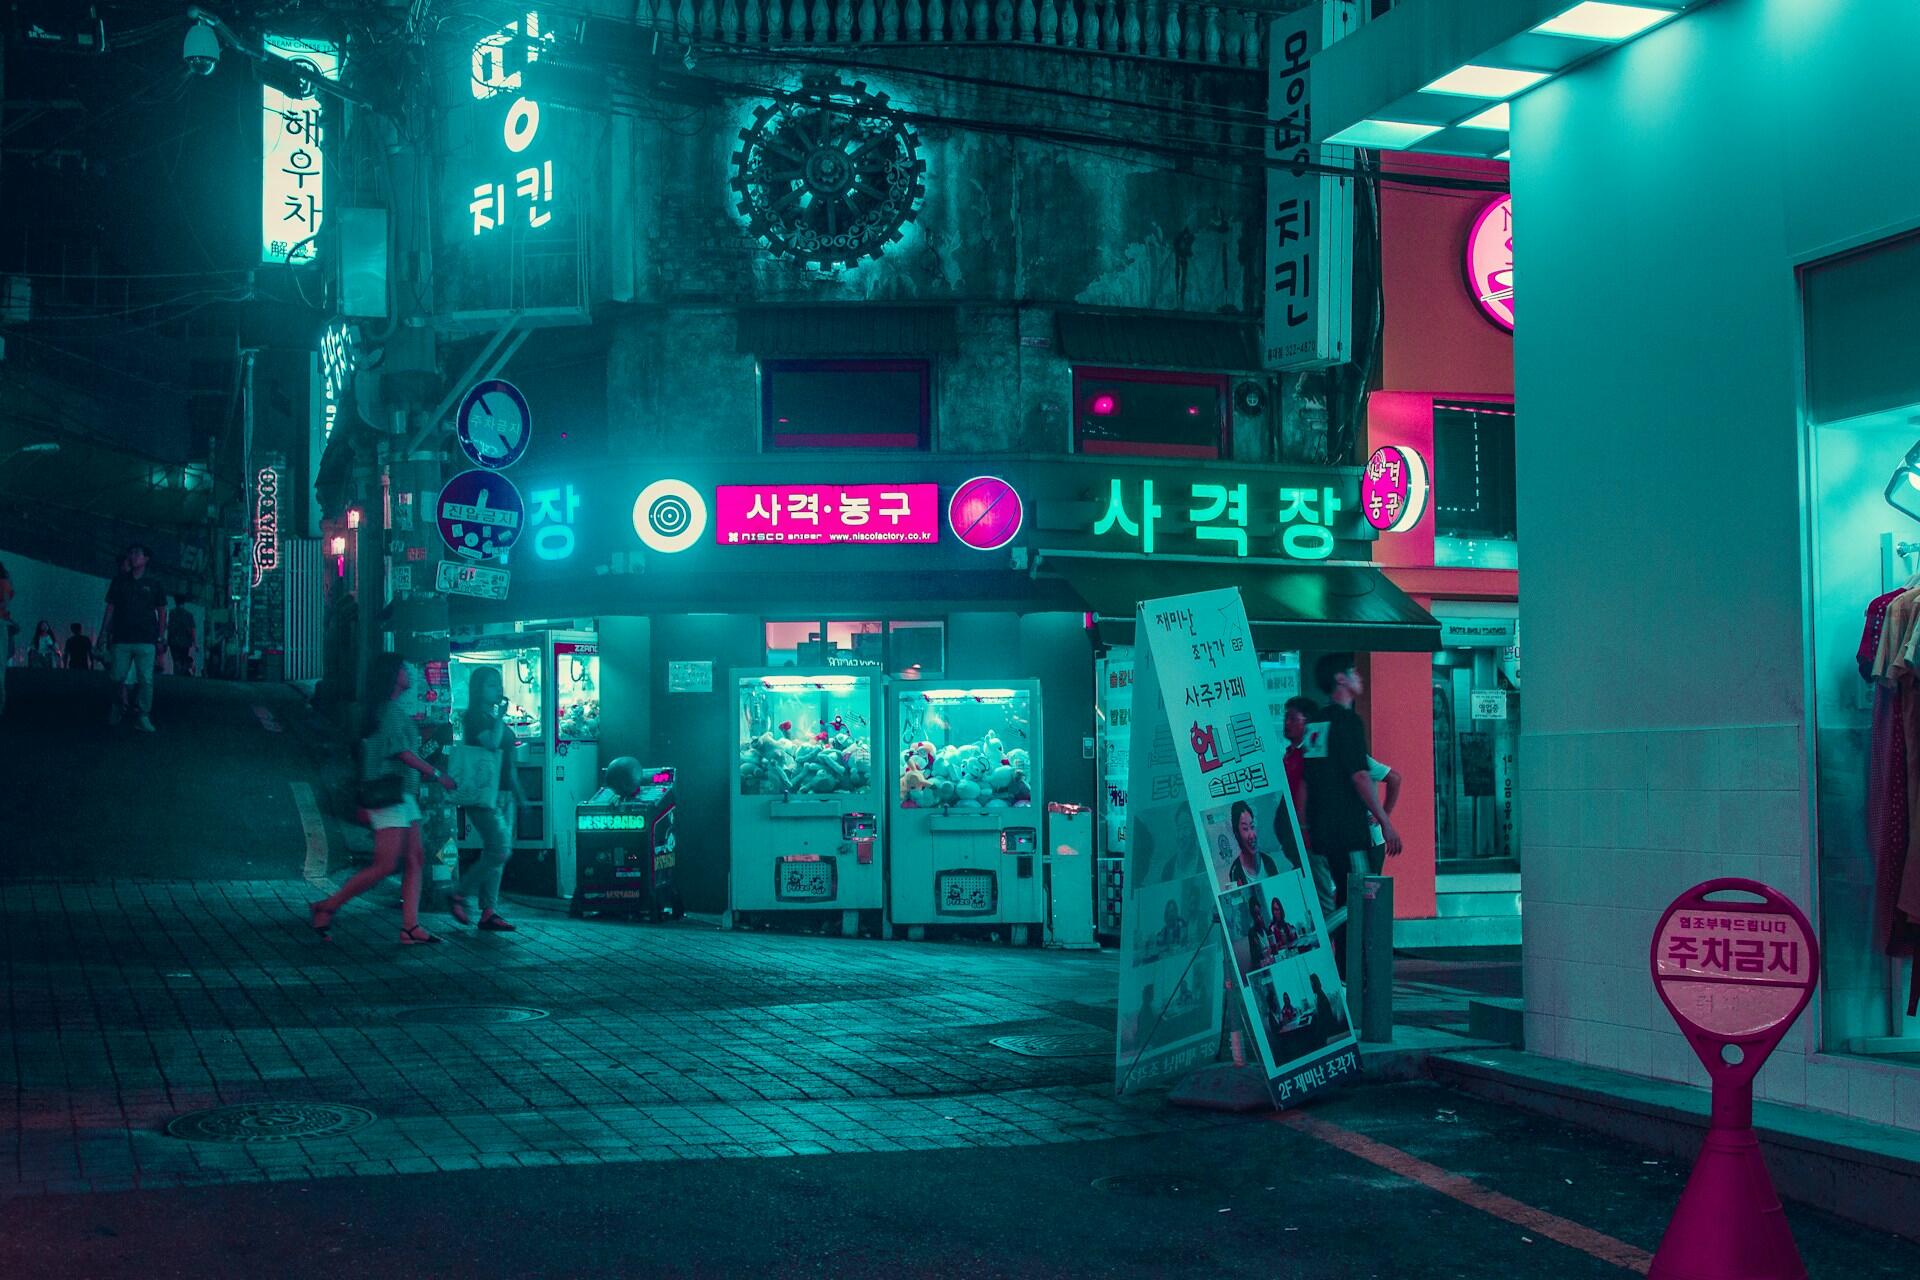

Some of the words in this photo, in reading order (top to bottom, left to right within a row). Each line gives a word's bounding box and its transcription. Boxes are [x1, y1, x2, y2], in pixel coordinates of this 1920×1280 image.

[281, 109, 322, 233] 해우차
[469, 160, 553, 236] 치킨
[1274, 198, 1310, 327] 치킨
[471, 414, 520, 437] 주차금지
[531, 484, 580, 561] 장
[1368, 489, 1400, 520] 농구
[1155, 607, 1197, 637] 재미난
[1191, 638, 1225, 668] 조각가
[1185, 676, 1246, 708] 사주카페
[1208, 762, 1269, 798] 슬램덩크
[1667, 935, 1798, 976] 주차금지
[1278, 1079, 1292, 1100] 2F
[1293, 1065, 1327, 1093] 재미난
[1326, 1051, 1357, 1078] 조각가
